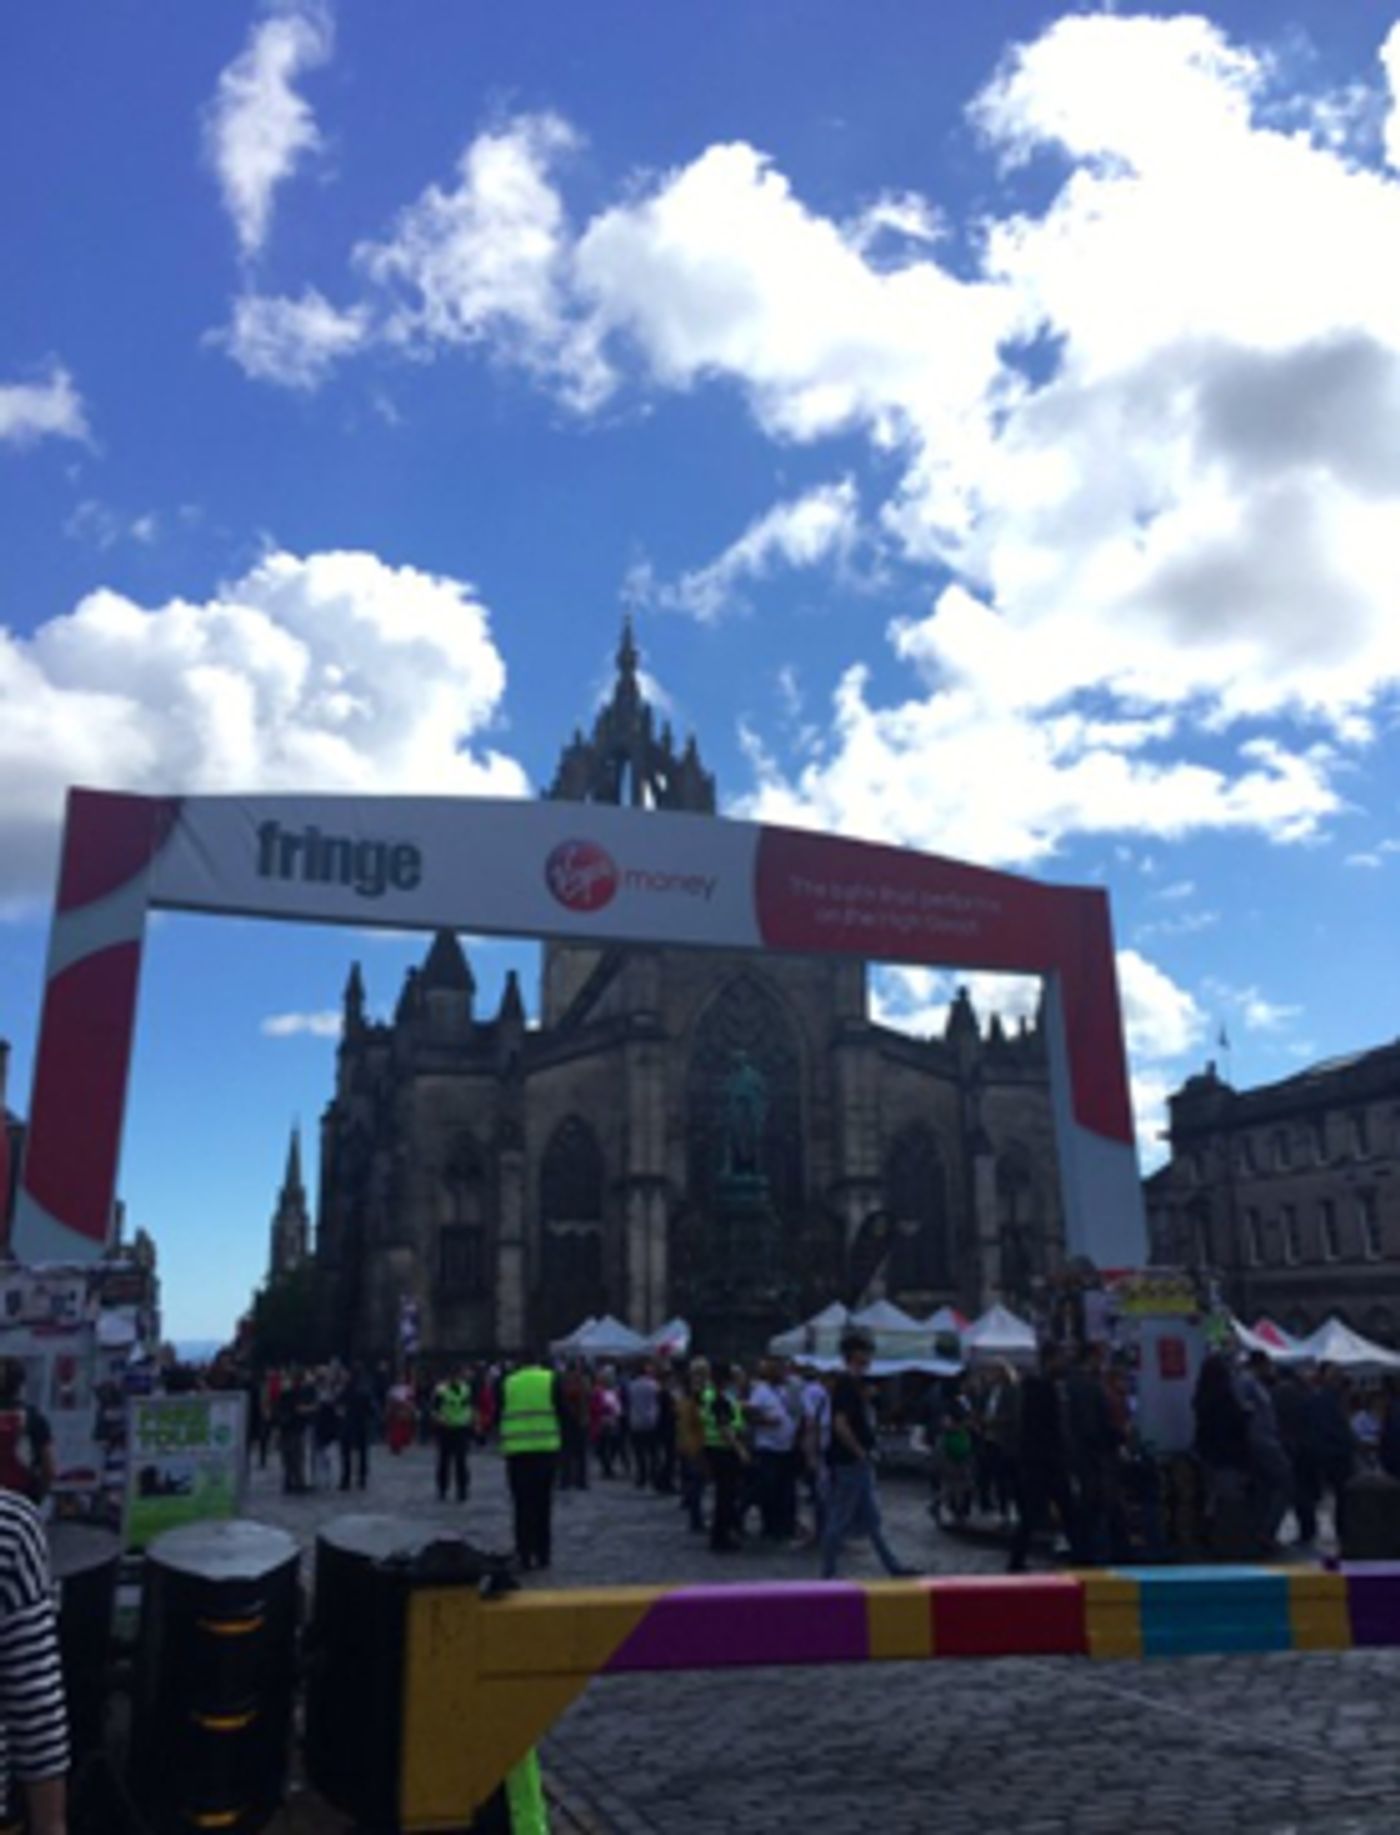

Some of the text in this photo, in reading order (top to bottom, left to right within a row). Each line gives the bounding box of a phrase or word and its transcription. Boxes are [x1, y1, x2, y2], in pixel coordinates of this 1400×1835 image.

[256, 820, 422, 898] fringe
[551, 843, 614, 904] Virgin
[624, 867, 717, 902] money
